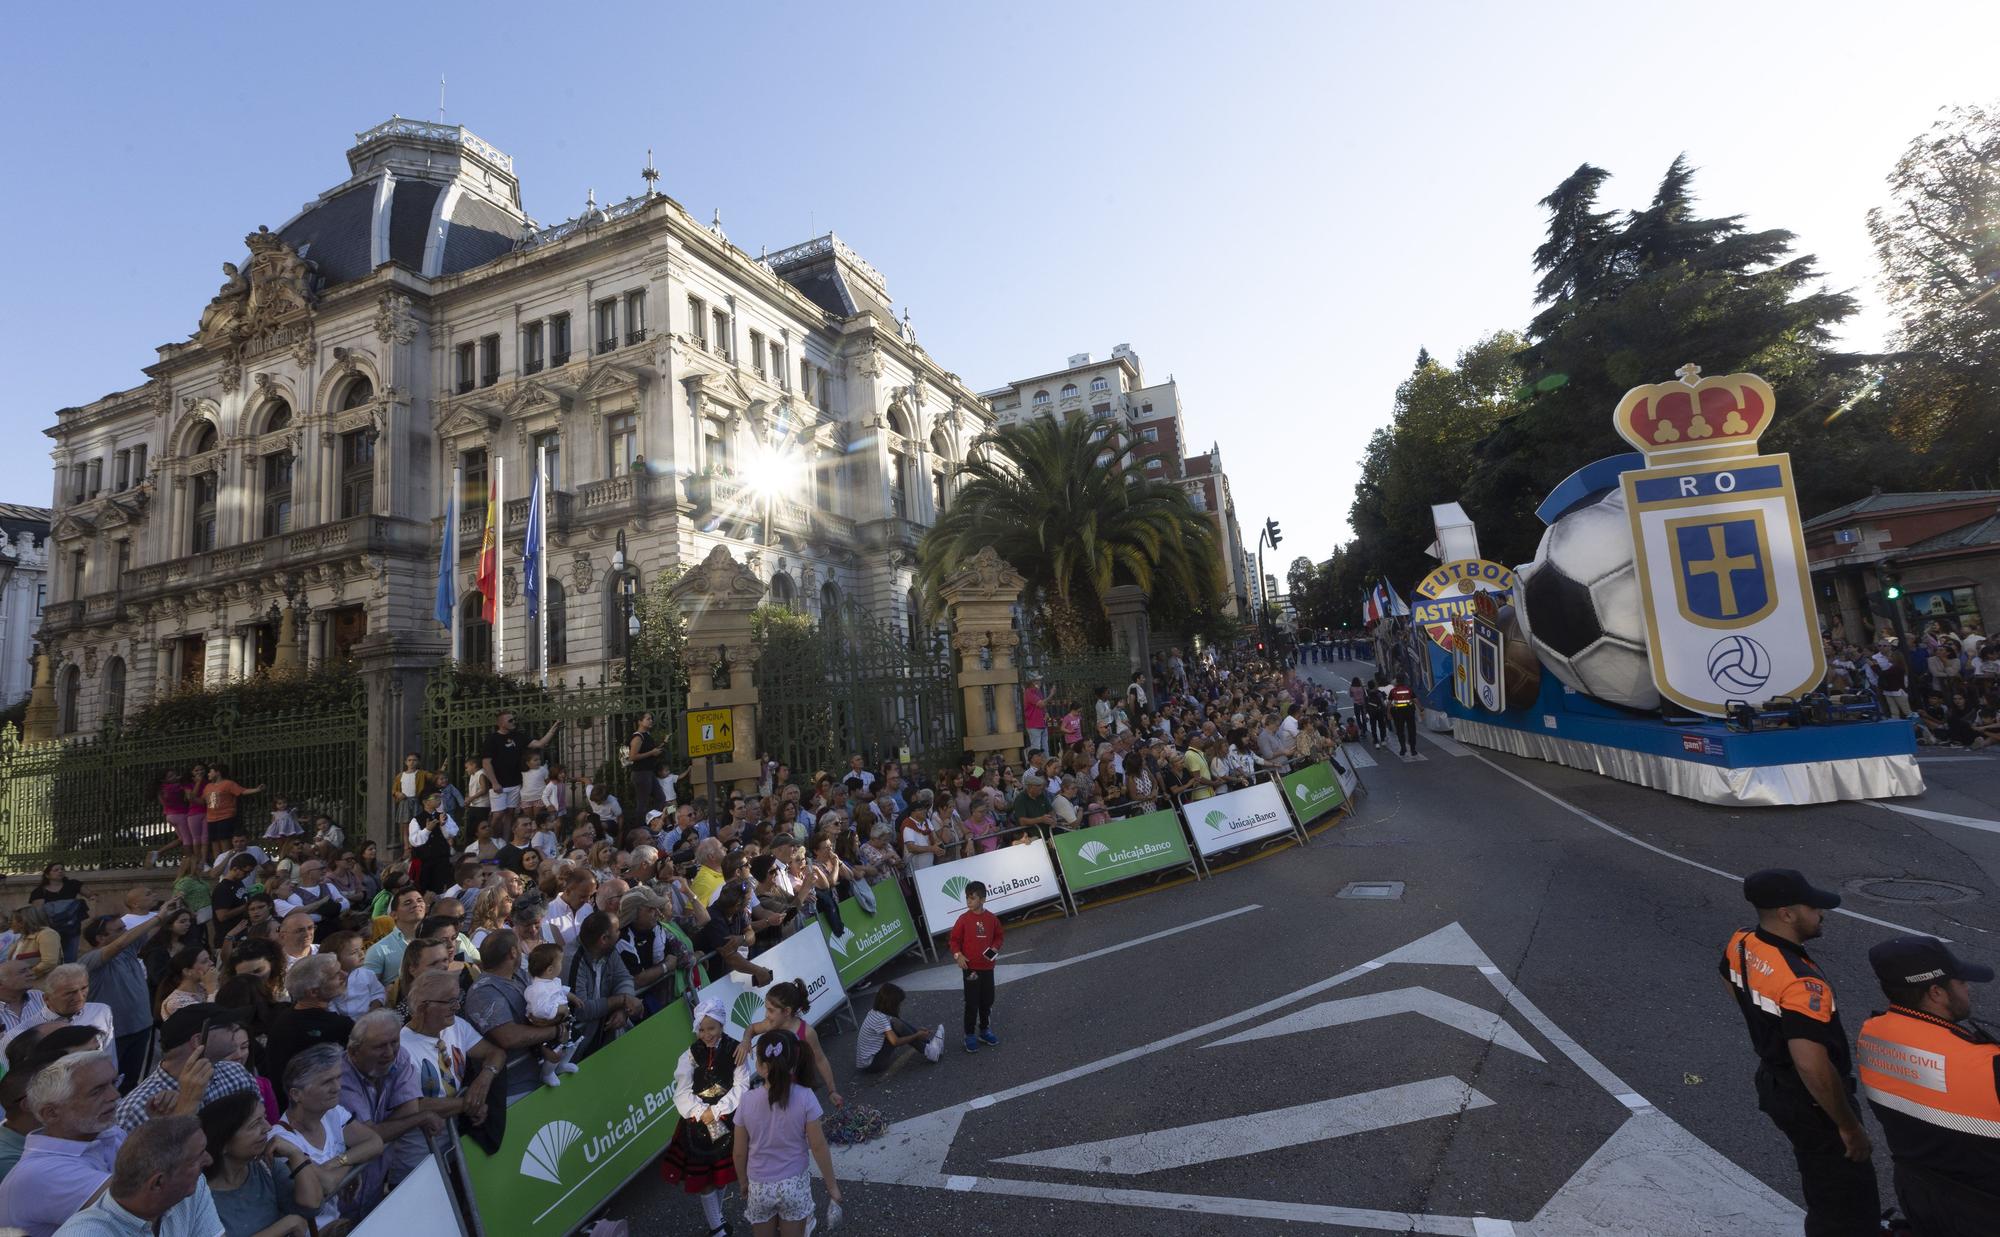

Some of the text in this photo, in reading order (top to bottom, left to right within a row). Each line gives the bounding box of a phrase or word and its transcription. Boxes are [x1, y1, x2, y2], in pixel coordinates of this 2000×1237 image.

[1422, 562, 1511, 596] FUTBOL
[696, 712, 724, 723] OFICINA
[690, 741, 731, 754] DE TURISMO
[1229, 810, 1277, 830] Unicaja Banco
[1109, 840, 1171, 863] Unicaja Banco
[985, 875, 1040, 897] nicaja Banco
[856, 918, 901, 951] Unicaja Banco
[807, 975, 827, 995] anco
[1909, 1054, 1943, 1071] CIVIL
[583, 1080, 678, 1163] Unicaja Banc
